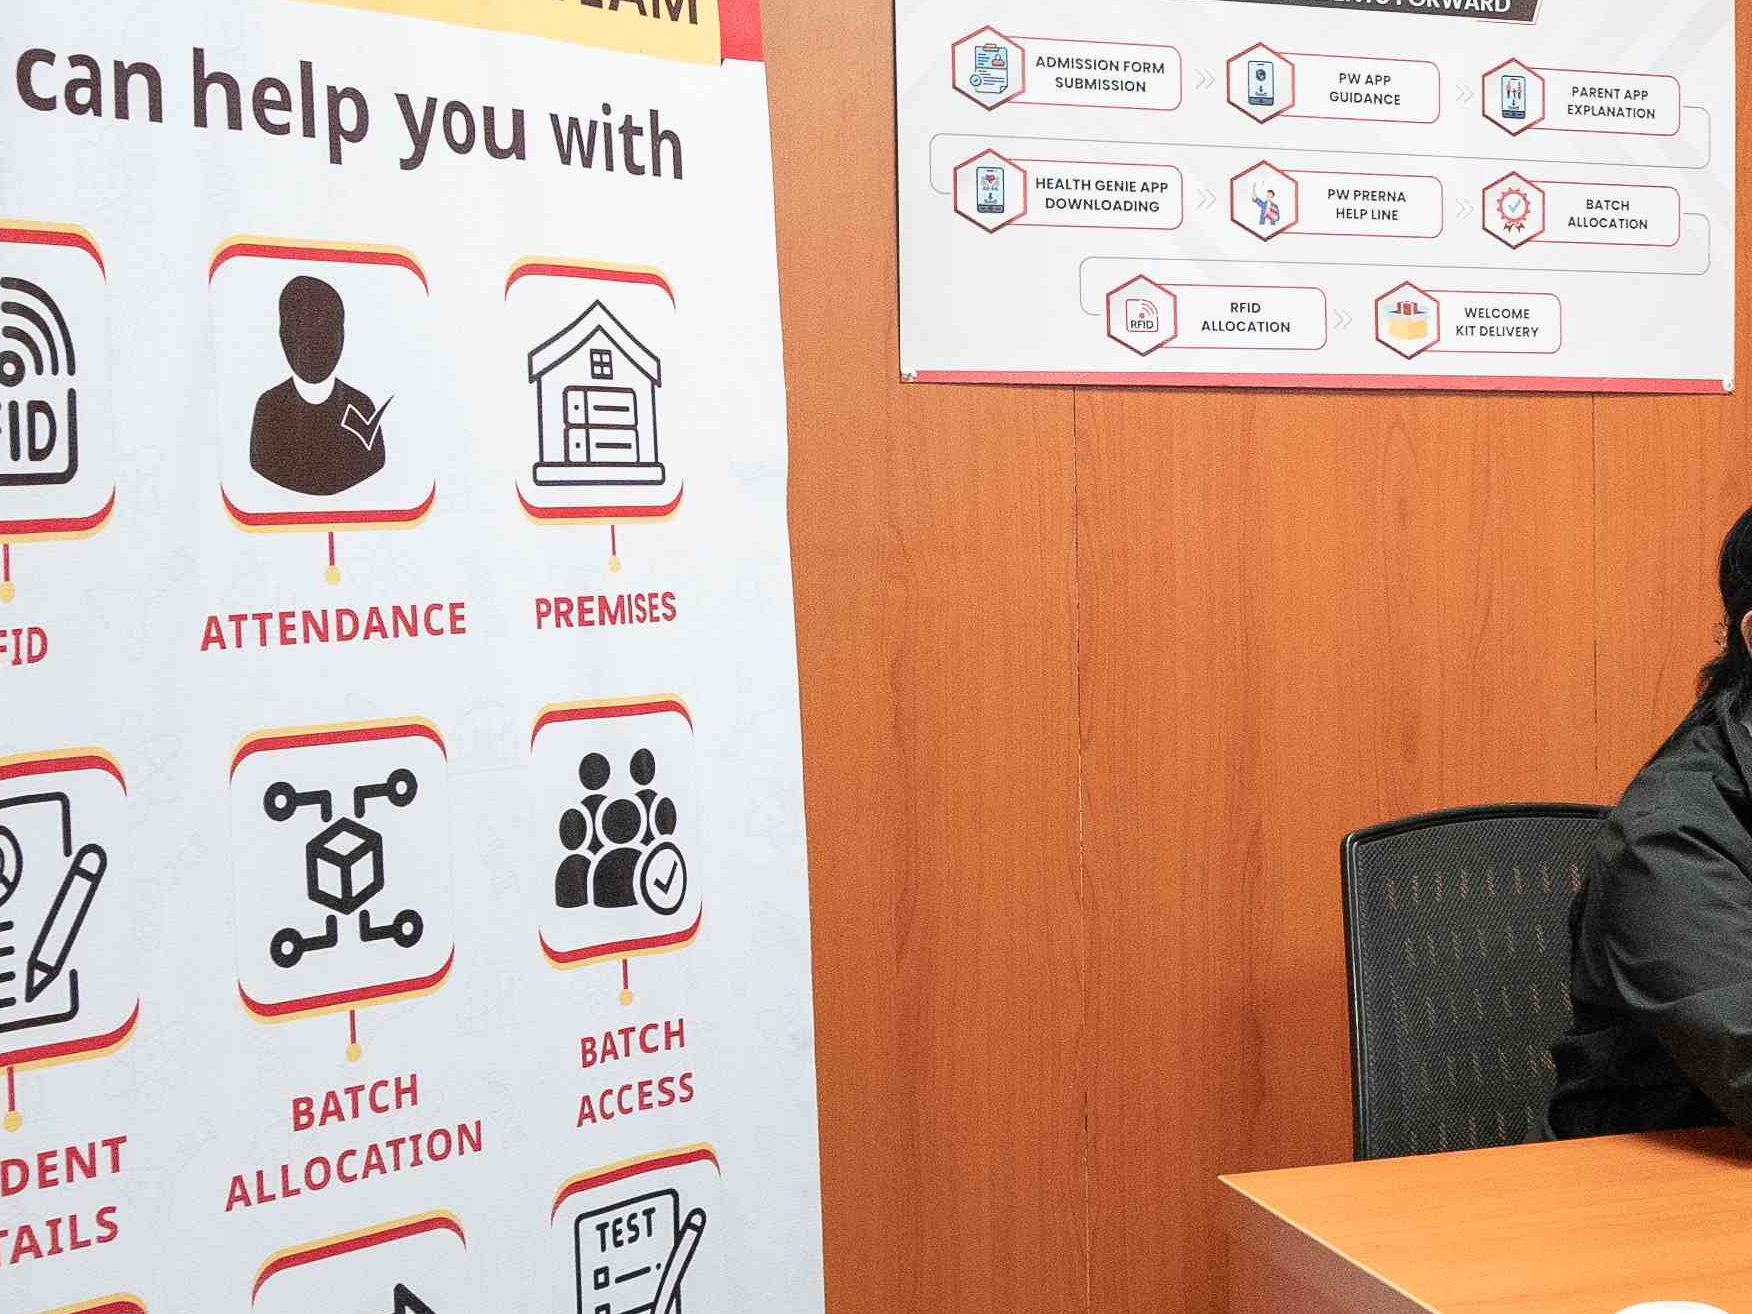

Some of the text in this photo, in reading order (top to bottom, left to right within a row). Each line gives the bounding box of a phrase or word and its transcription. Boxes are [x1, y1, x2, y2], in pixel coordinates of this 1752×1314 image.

[1035, 56, 1165, 74] ADMISSION FORM
[1055, 77, 1146, 93] SUBMISSION
[1339, 73, 1392, 86] PW APP
[1329, 91, 1401, 106] GUIDANCE
[1571, 86, 1649, 101] PARENT APP
[15, 50, 165, 124] can
[194, 47, 370, 165] help
[397, 94, 527, 171] you
[550, 104, 684, 180] with
[1567, 105, 1656, 119] EXPLANATION
[1035, 178, 1168, 194] HEALTH GENIE APP
[1328, 189, 1407, 203] PW PRERNA
[1045, 198, 1160, 213] DOWNLOADING
[1586, 199, 1630, 212] BATCH
[1336, 208, 1399, 221] HELP LINE
[1568, 216, 1648, 230] ALLOCATION
[1230, 302, 1261, 314] RFID
[1464, 307, 1530, 319] WELCOME
[1130, 319, 1154, 330] RFID
[1201, 320, 1291, 333] ALLOCATION
[1455, 325, 1539, 338] KIT DELIVERY
[534, 590, 679, 631] PREMISES
[200, 601, 467, 652] ATTENDANCE
[579, 1018, 686, 1070] BATCH
[290, 1074, 420, 1134] BATCH
[575, 1073, 697, 1128] ACCESS
[223, 1120, 485, 1213] ALLOCATION
[595, 1207, 657, 1254] TEST
